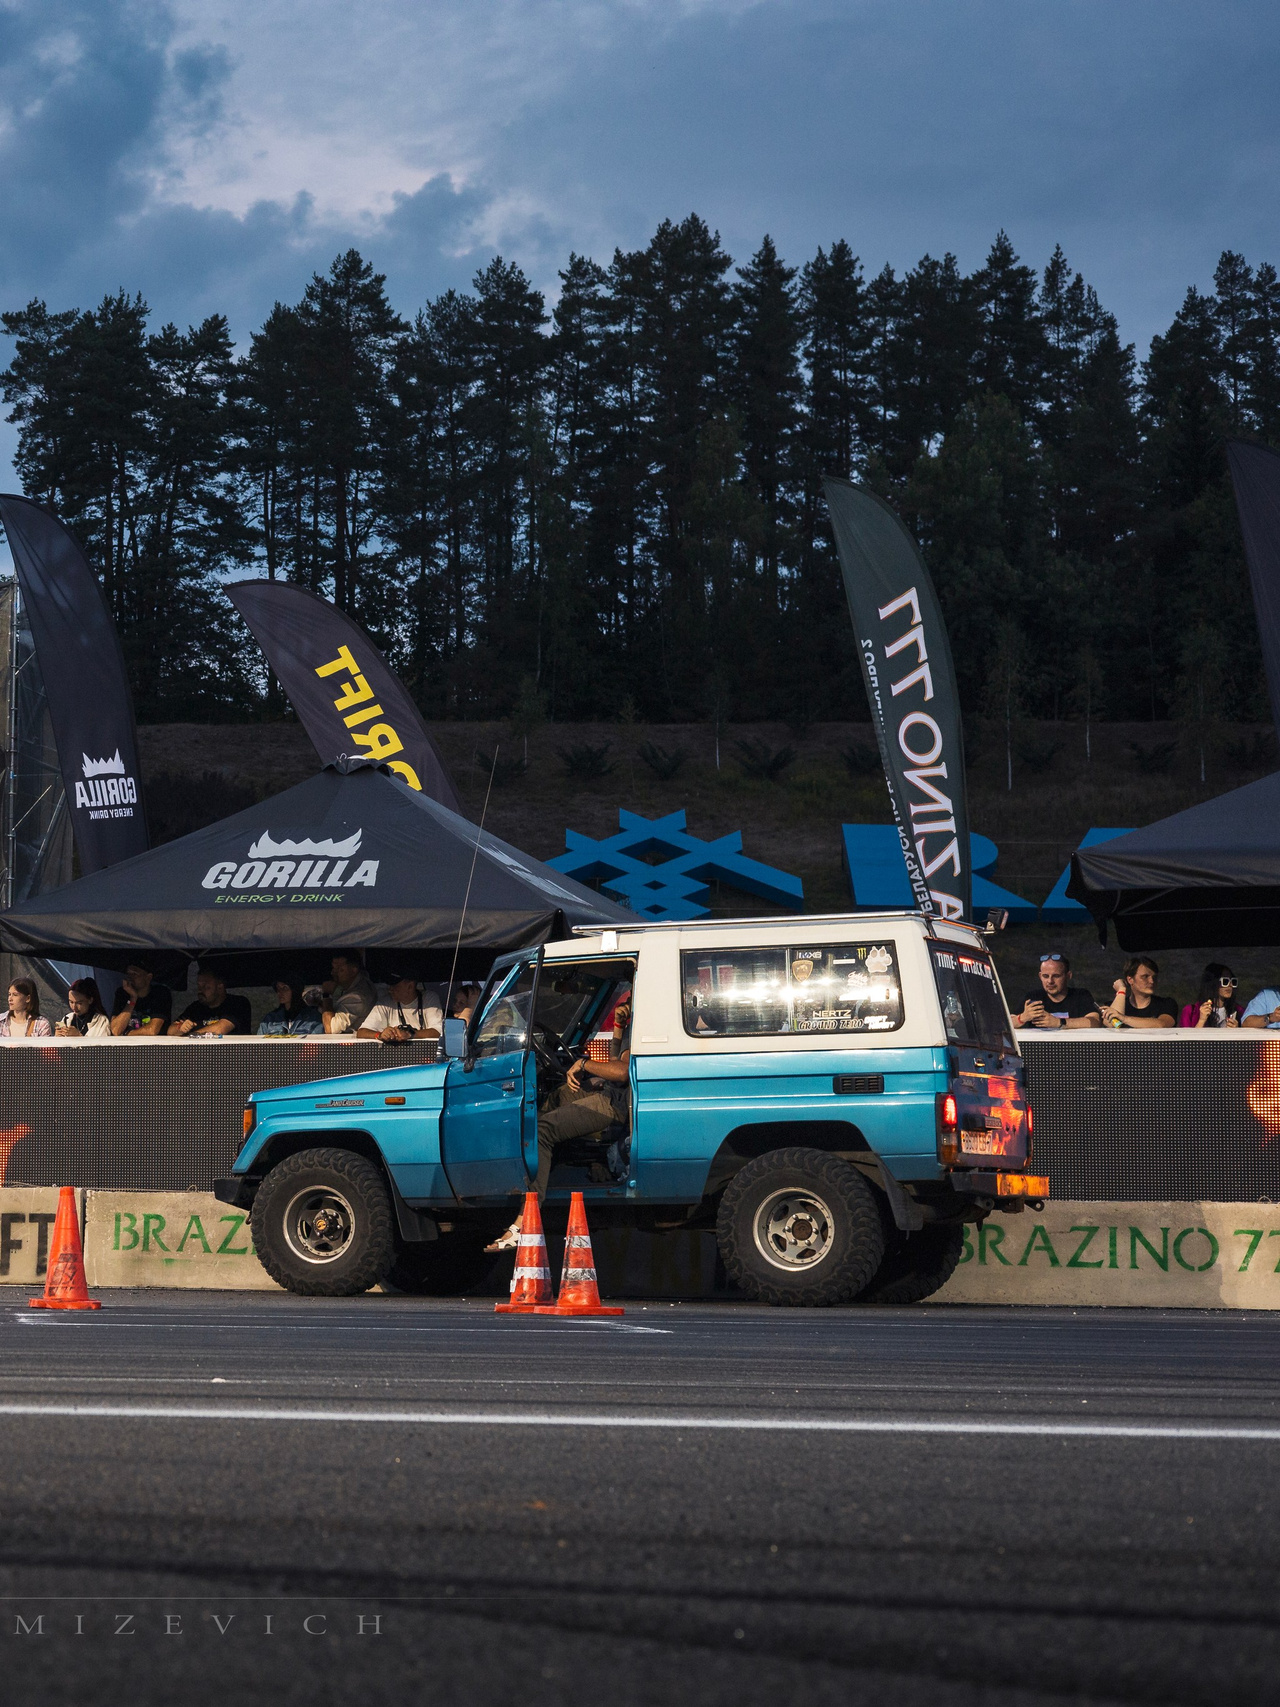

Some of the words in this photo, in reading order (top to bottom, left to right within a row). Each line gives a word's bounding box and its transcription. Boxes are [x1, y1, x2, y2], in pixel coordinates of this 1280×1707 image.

[201, 860, 380, 889] GORILLA
[215, 894, 286, 903] ENERGY
[290, 893, 345, 902] DRINK
[112, 1212, 258, 1255] BRAZ
